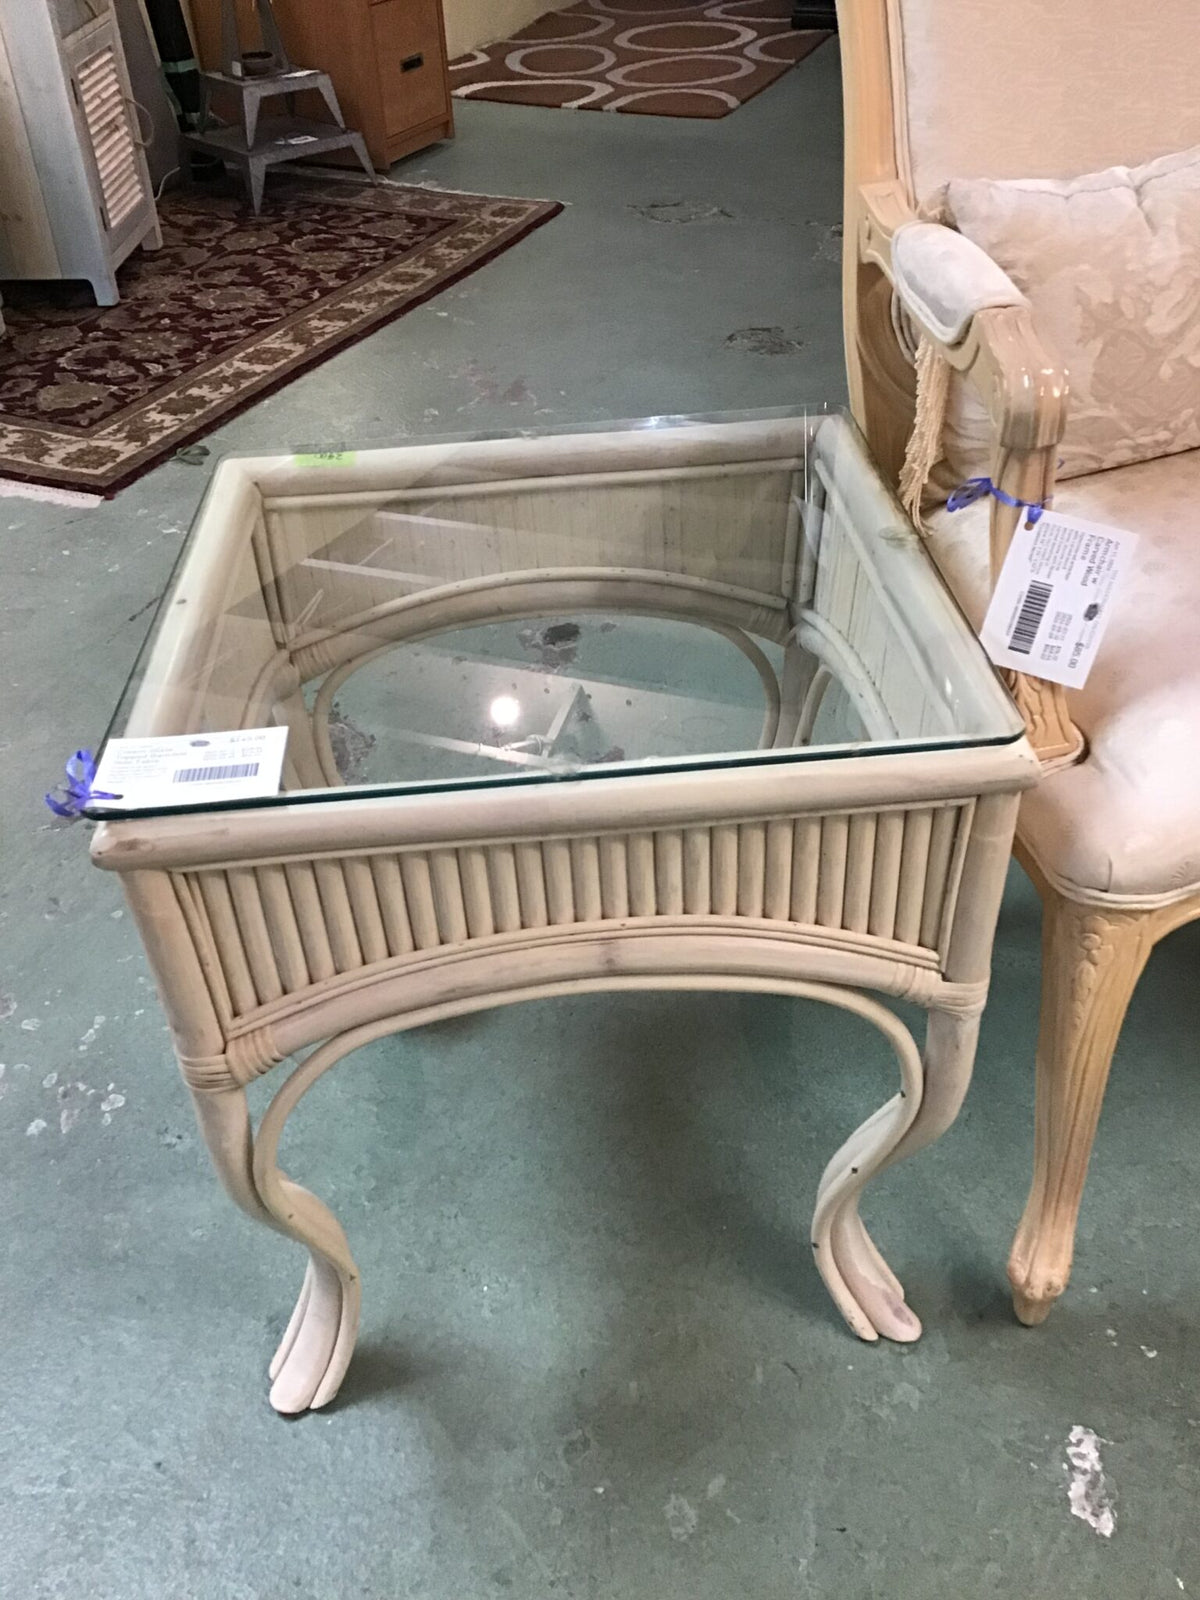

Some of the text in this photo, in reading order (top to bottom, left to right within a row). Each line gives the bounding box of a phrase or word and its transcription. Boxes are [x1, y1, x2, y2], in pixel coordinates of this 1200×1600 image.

[1080, 533, 1094, 560] Frame
[1080, 535, 1103, 586] Carved Wood
[1093, 538, 1113, 575] Armchair
[1067, 641, 1084, 669] $85.00
